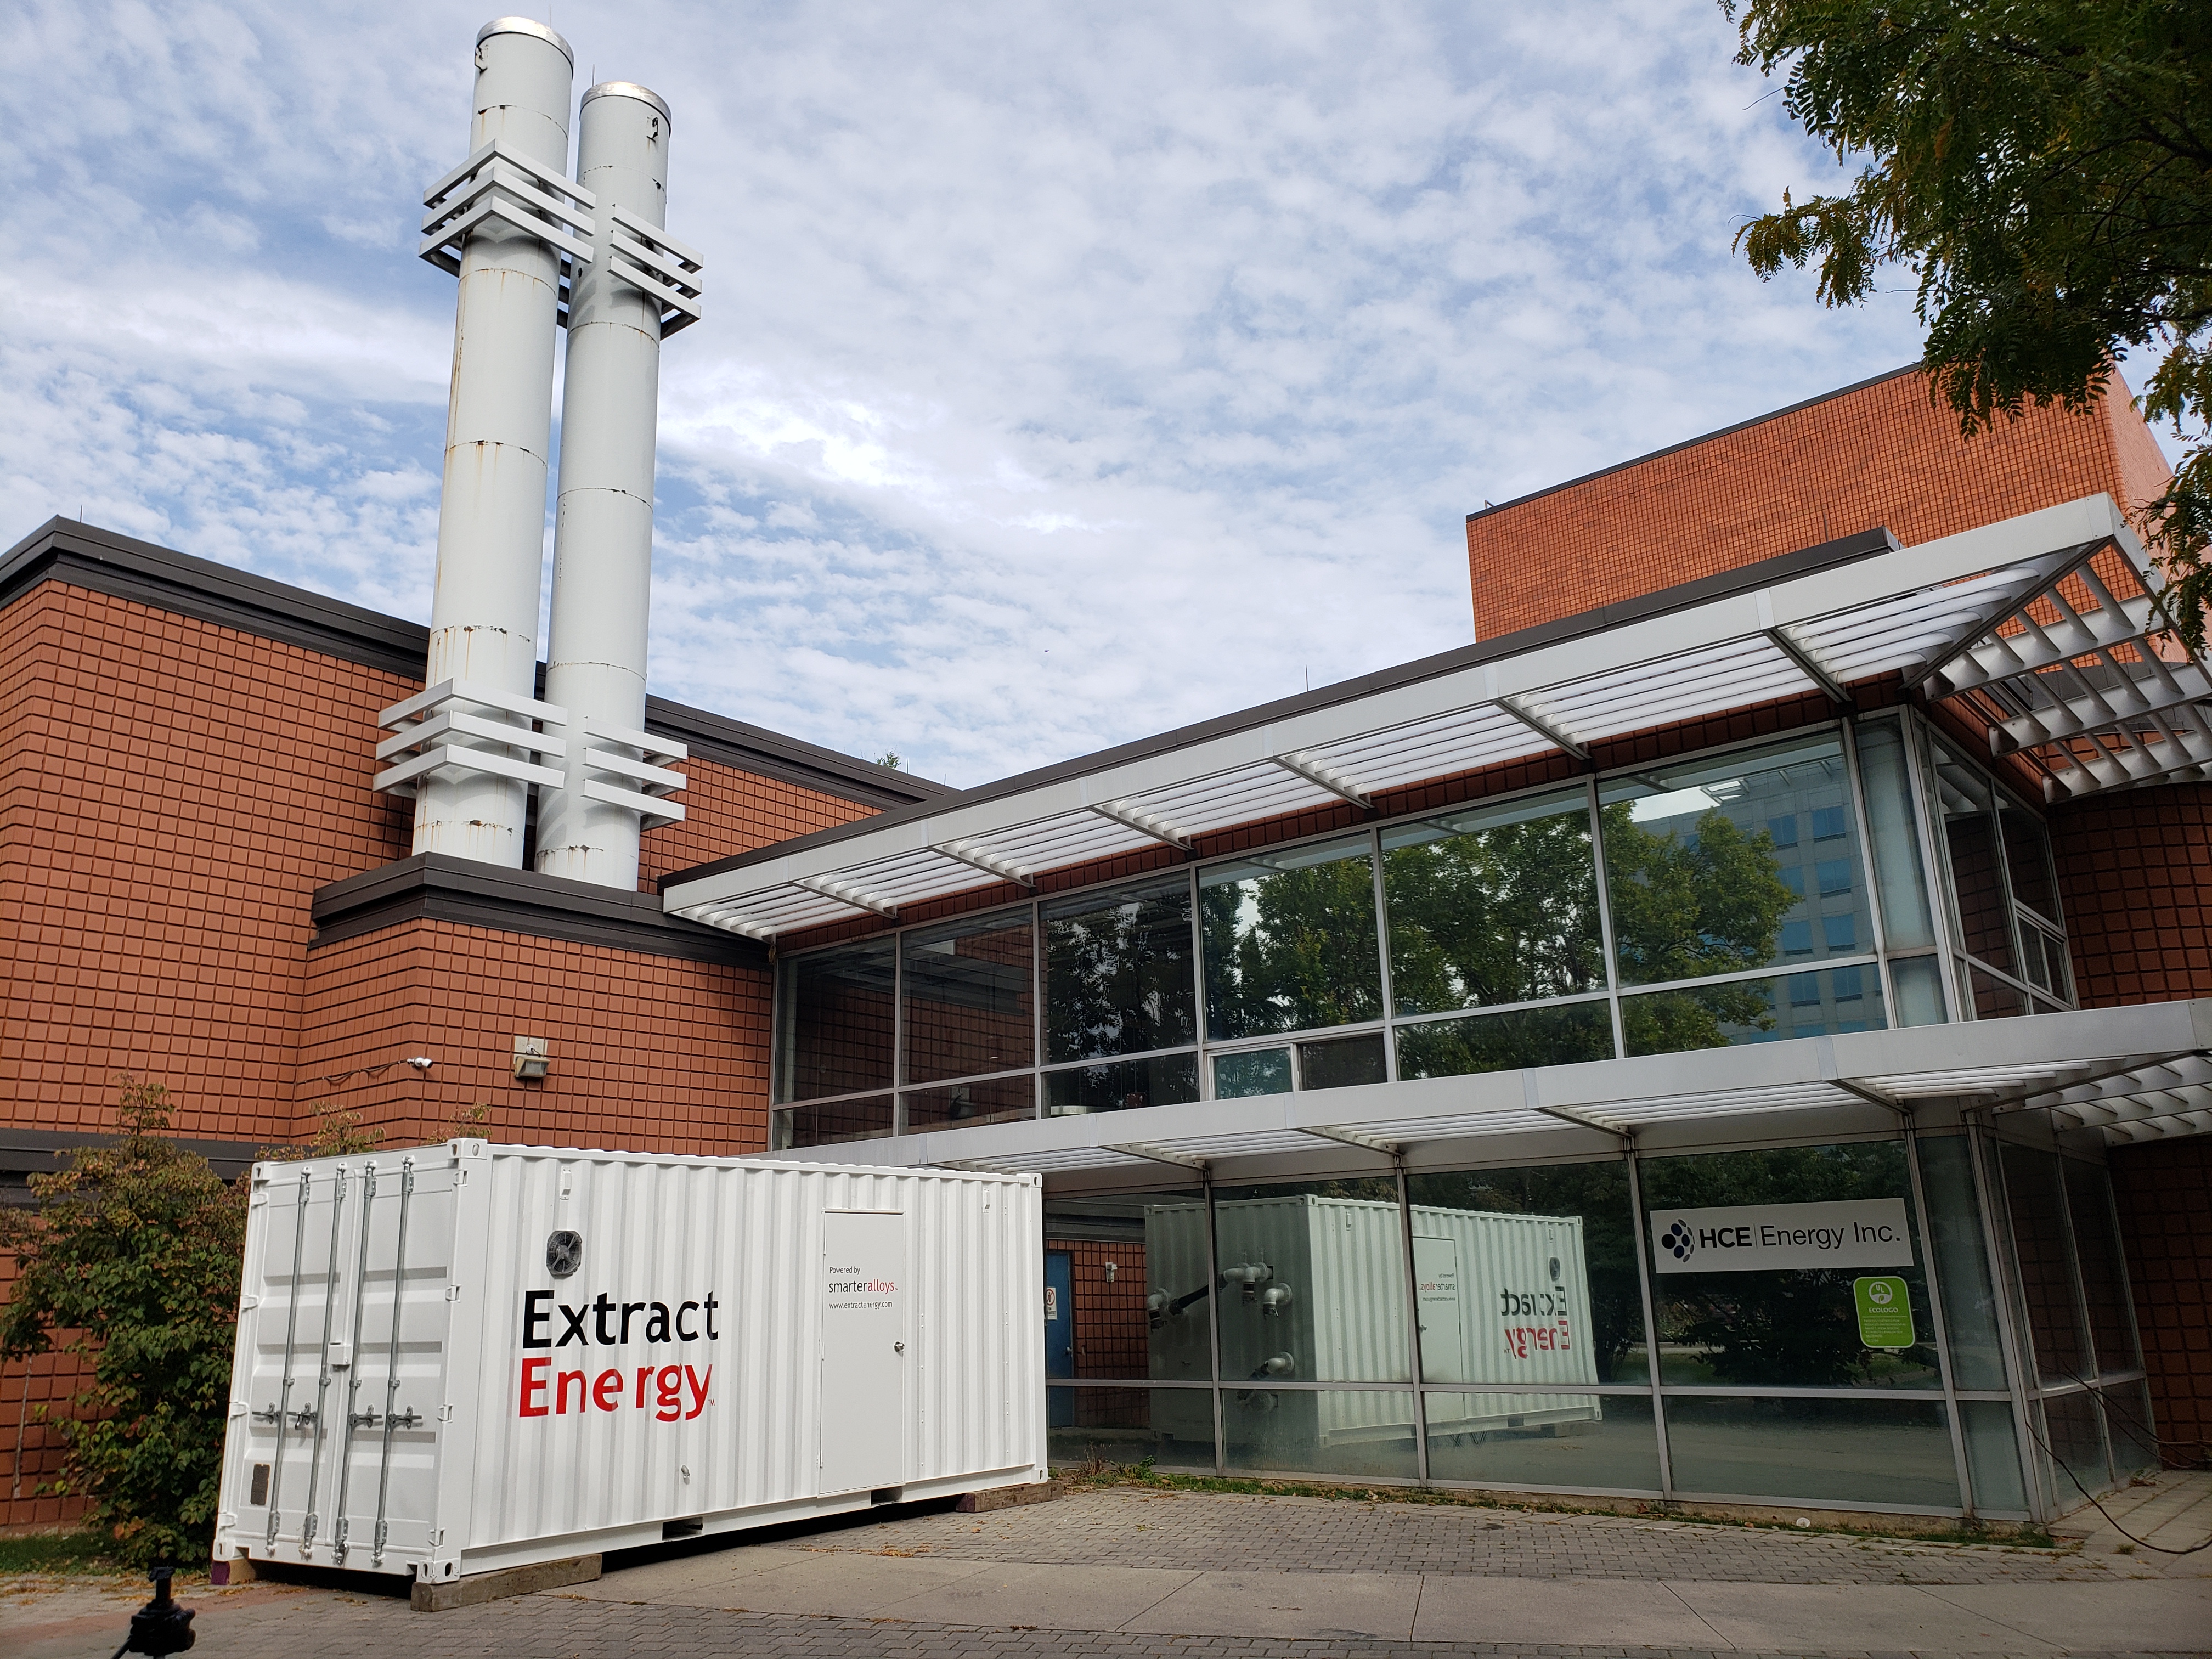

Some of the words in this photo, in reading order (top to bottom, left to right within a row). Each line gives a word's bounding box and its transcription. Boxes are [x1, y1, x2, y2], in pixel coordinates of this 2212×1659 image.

[1699, 1227, 1752, 1249] HCE
[1760, 1225, 1844, 1250] Energy
[1853, 1222, 1901, 1243] Inc.
[854, 1266, 861, 1275] by
[1876, 1284, 1884, 1293] UL
[829, 1301, 893, 1310] www.extractenergy.com
[523, 1290, 719, 1349] Extract
[519, 1357, 713, 1422] Energy
